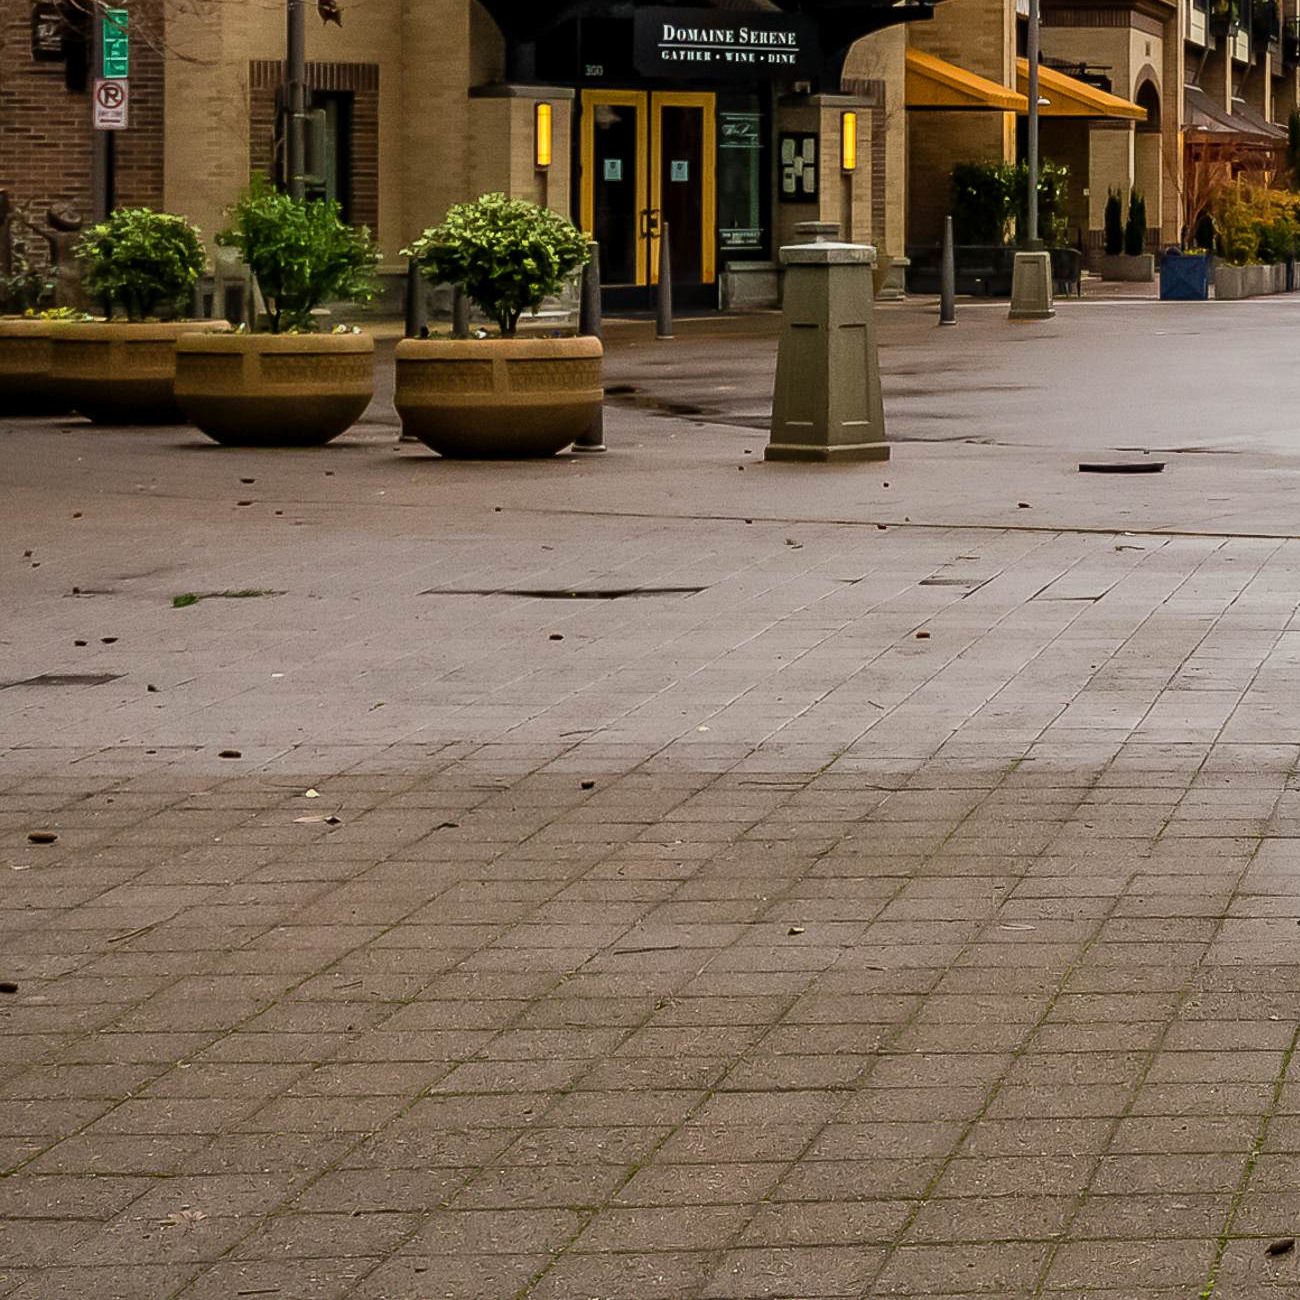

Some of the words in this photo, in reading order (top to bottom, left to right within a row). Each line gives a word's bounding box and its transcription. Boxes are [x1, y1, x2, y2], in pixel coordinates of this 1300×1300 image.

[661, 50, 711, 61] GATHER
[725, 52, 755, 63] WINE
[768, 53, 796, 64] DINE
